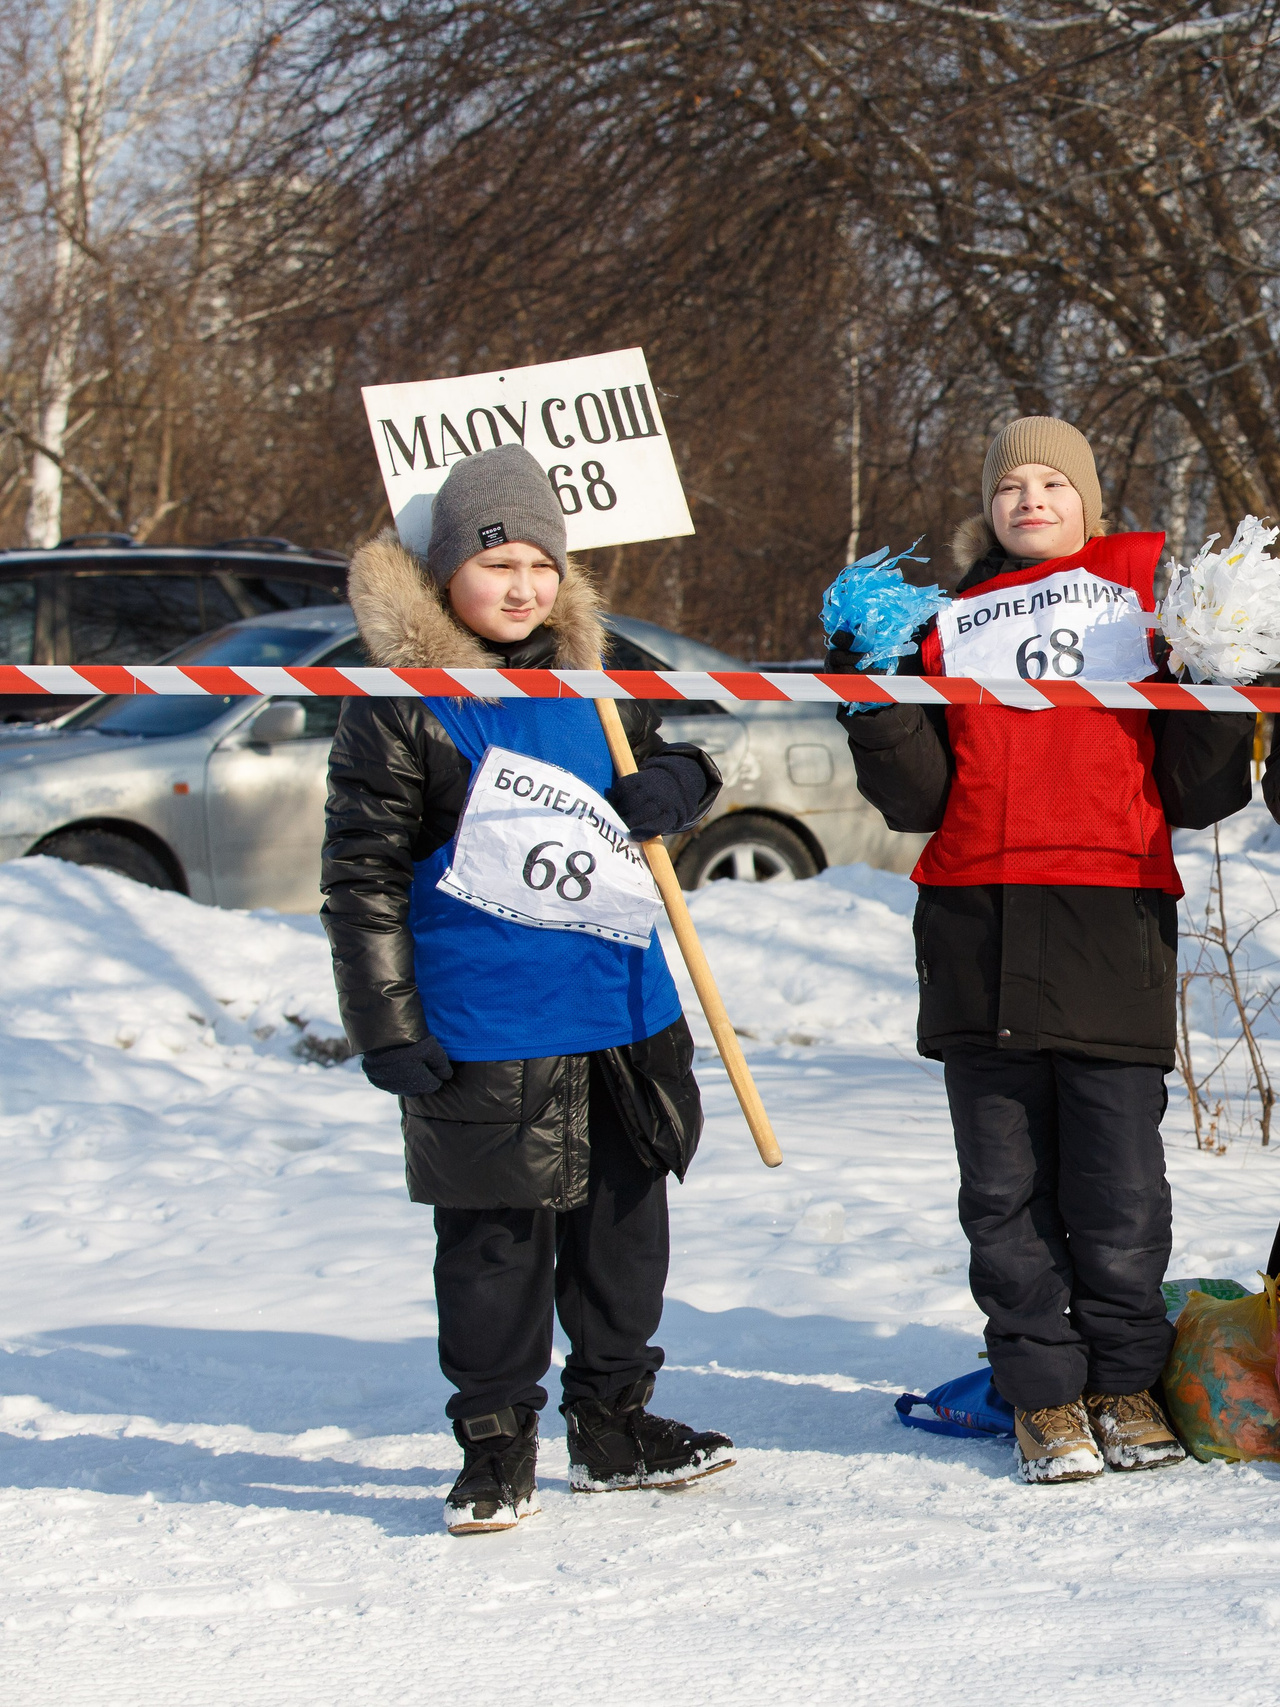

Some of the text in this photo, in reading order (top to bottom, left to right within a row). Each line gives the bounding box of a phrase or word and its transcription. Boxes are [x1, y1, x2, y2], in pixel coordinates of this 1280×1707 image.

[377, 383, 662, 476] МАОУ СОШ
[548, 460, 617, 515] 68
[956, 582, 1128, 634] БОЛЕЛЬЩИК
[1016, 628, 1084, 680] 68
[522, 840, 597, 902] 68
